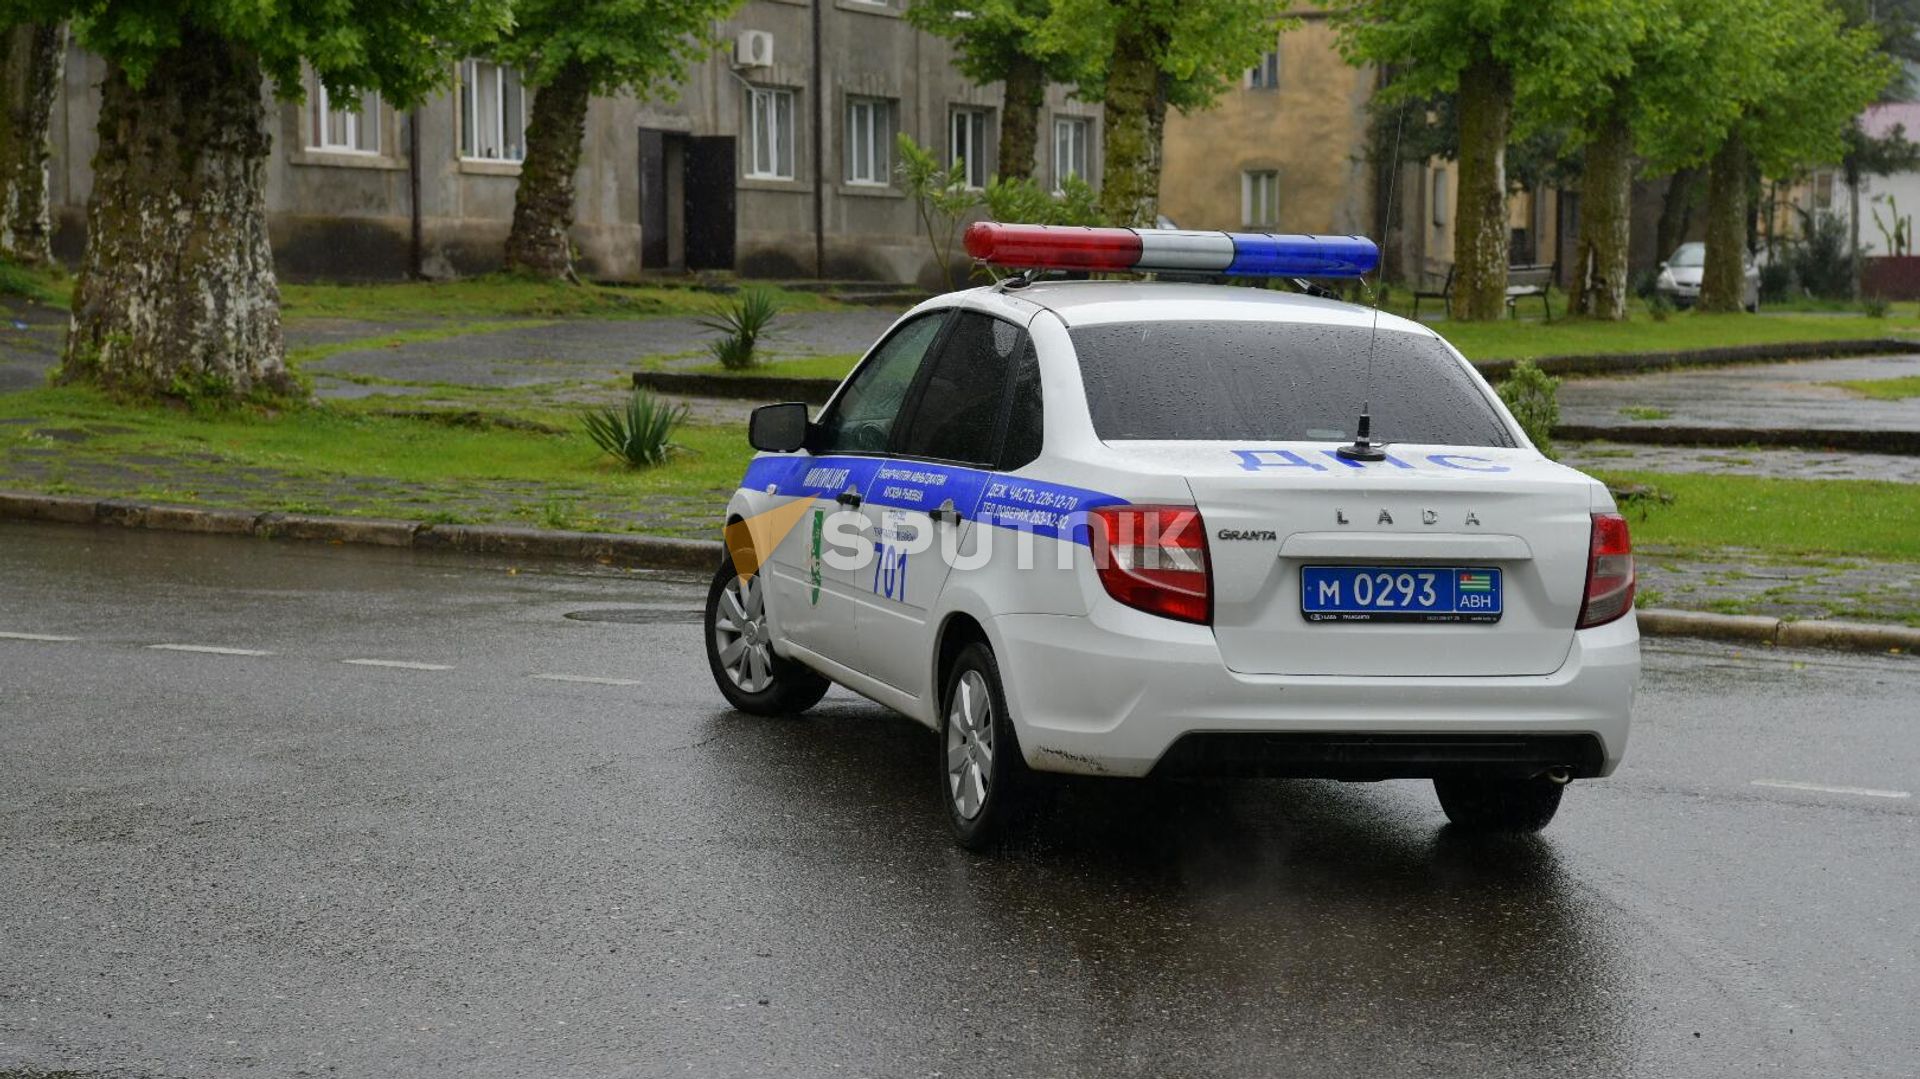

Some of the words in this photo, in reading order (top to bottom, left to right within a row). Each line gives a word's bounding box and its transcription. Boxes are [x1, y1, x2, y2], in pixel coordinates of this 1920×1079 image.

[1230, 450, 1511, 472] ДПС
[803, 468, 849, 492] МИЛИЦИЯ
[1336, 508, 1480, 525] LADA
[1218, 529, 1276, 541] GRANTA
[874, 542, 907, 602] 701
[1319, 580, 1340, 605] M
[1354, 574, 1436, 606] 0293
[1460, 595, 1491, 608] ABH
